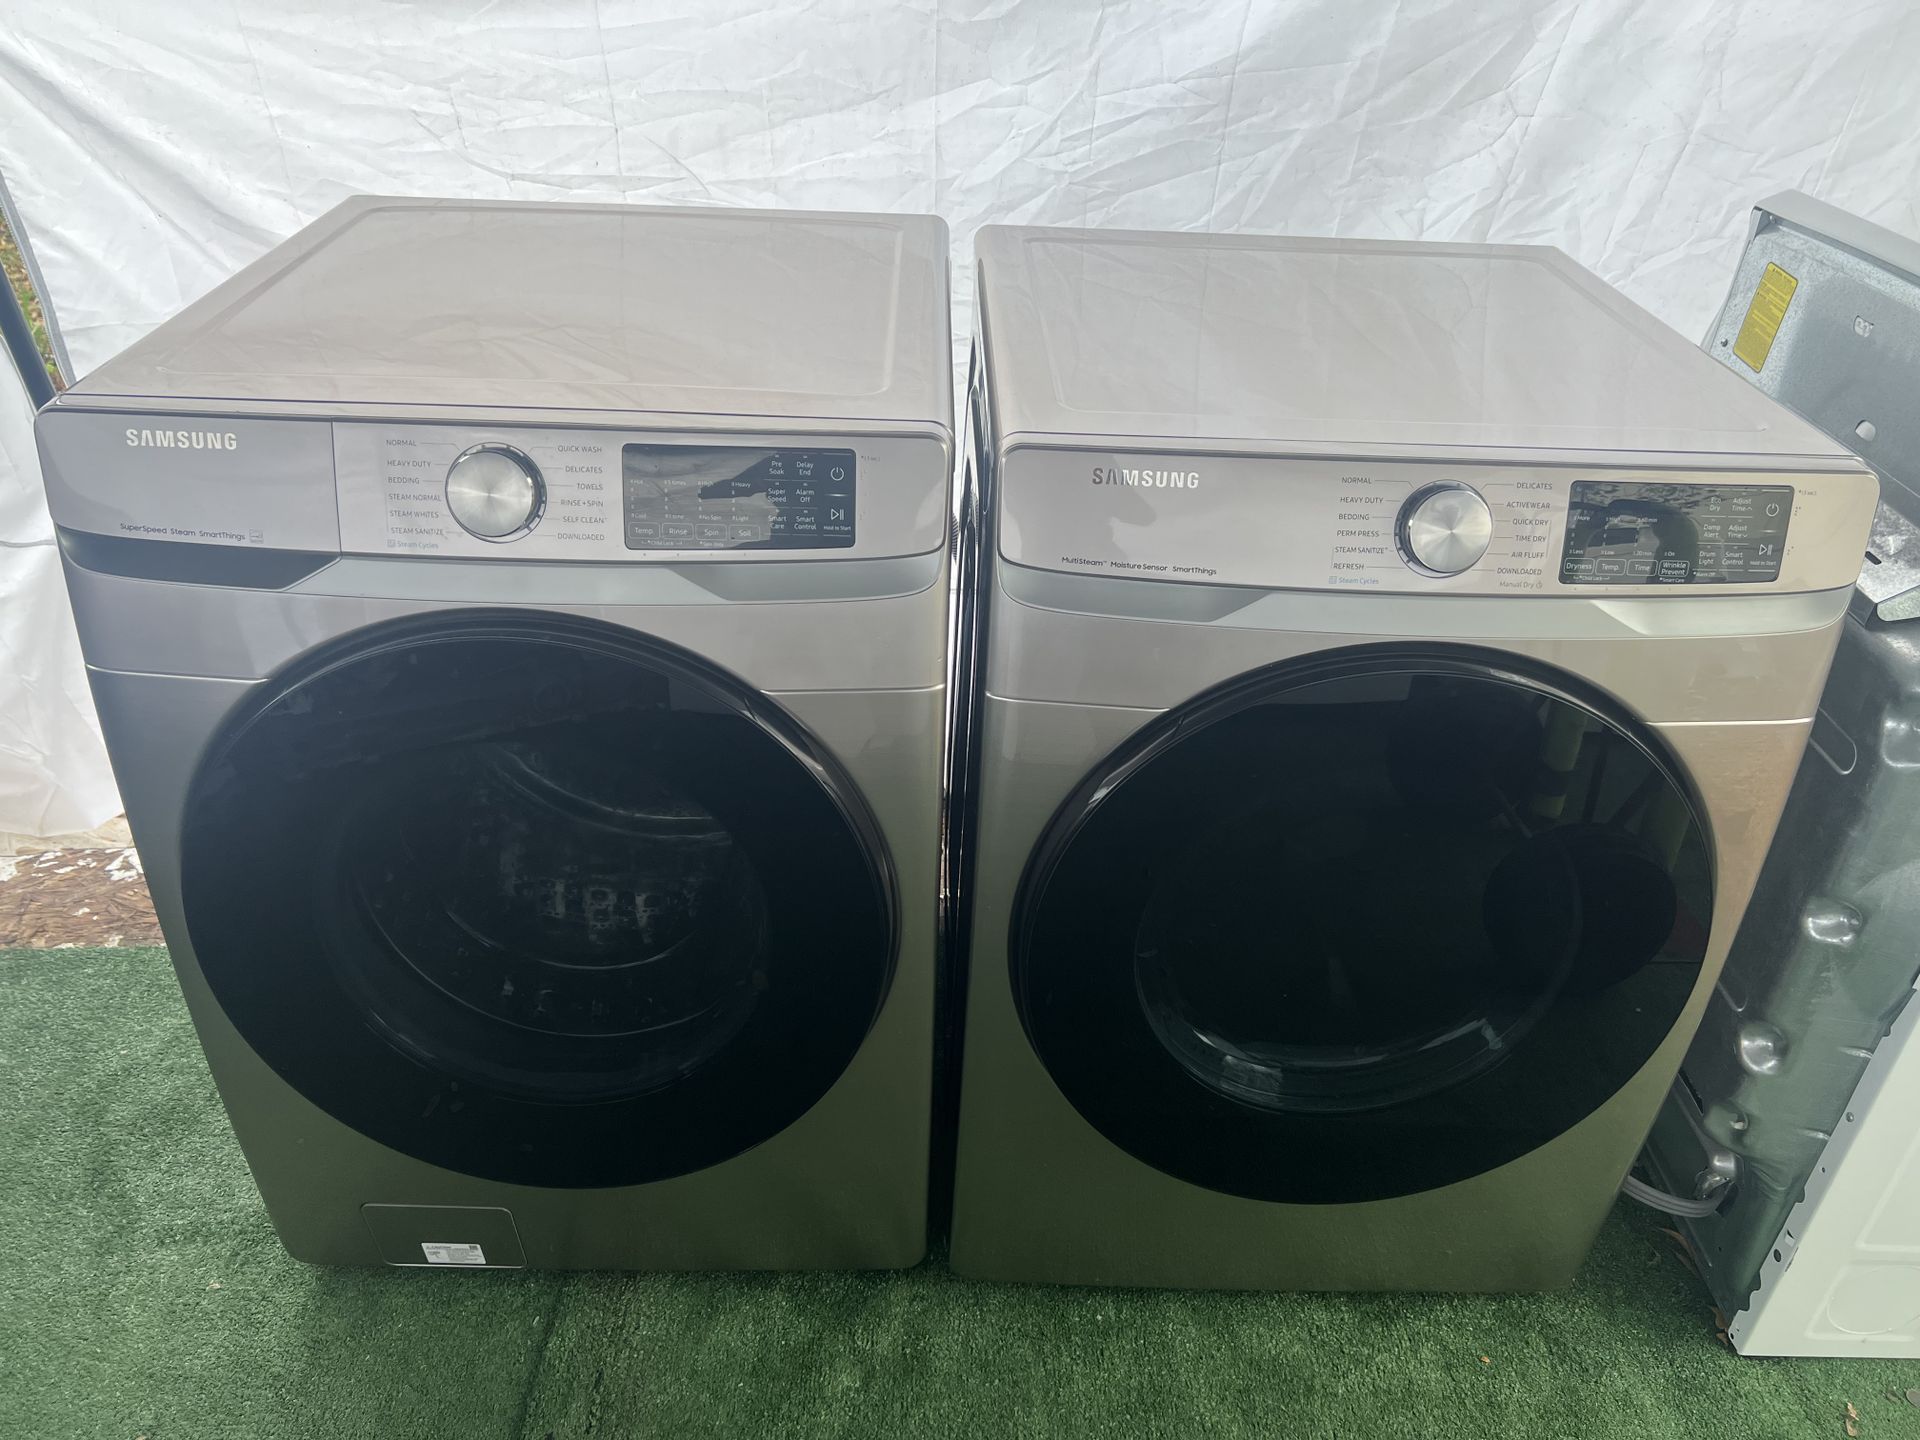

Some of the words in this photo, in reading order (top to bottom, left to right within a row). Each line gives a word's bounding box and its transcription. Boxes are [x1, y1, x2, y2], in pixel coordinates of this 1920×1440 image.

[126, 429, 237, 450] SAMSUNG
[386, 439, 416, 447] NORMAL
[558, 445, 580, 453] QUICK
[565, 465, 603, 474] DELICATES
[1092, 467, 1199, 488] SAMSUNG
[576, 482, 604, 491] TOWELS
[1516, 482, 1552, 490] DELICATES
[587, 500, 604, 508] SPIN
[414, 511, 440, 519] WHITES
[120, 523, 167, 535] SuperSpeed
[170, 528, 196, 537] Steam
[200, 530, 246, 541] SmartThings
[557, 532, 604, 541] DOWNLOADED
[635, 528, 654, 536] Temp
[1110, 561, 1142, 570] Moisture
[1142, 562, 1168, 572] Sensor
[1172, 566, 1217, 576] SmartThings
[1566, 562, 1592, 571] Dryness
[1602, 563, 1619, 572] Temp
[1497, 568, 1542, 576] DOWNLOADED
[1524, 582, 1534, 590] Dry
